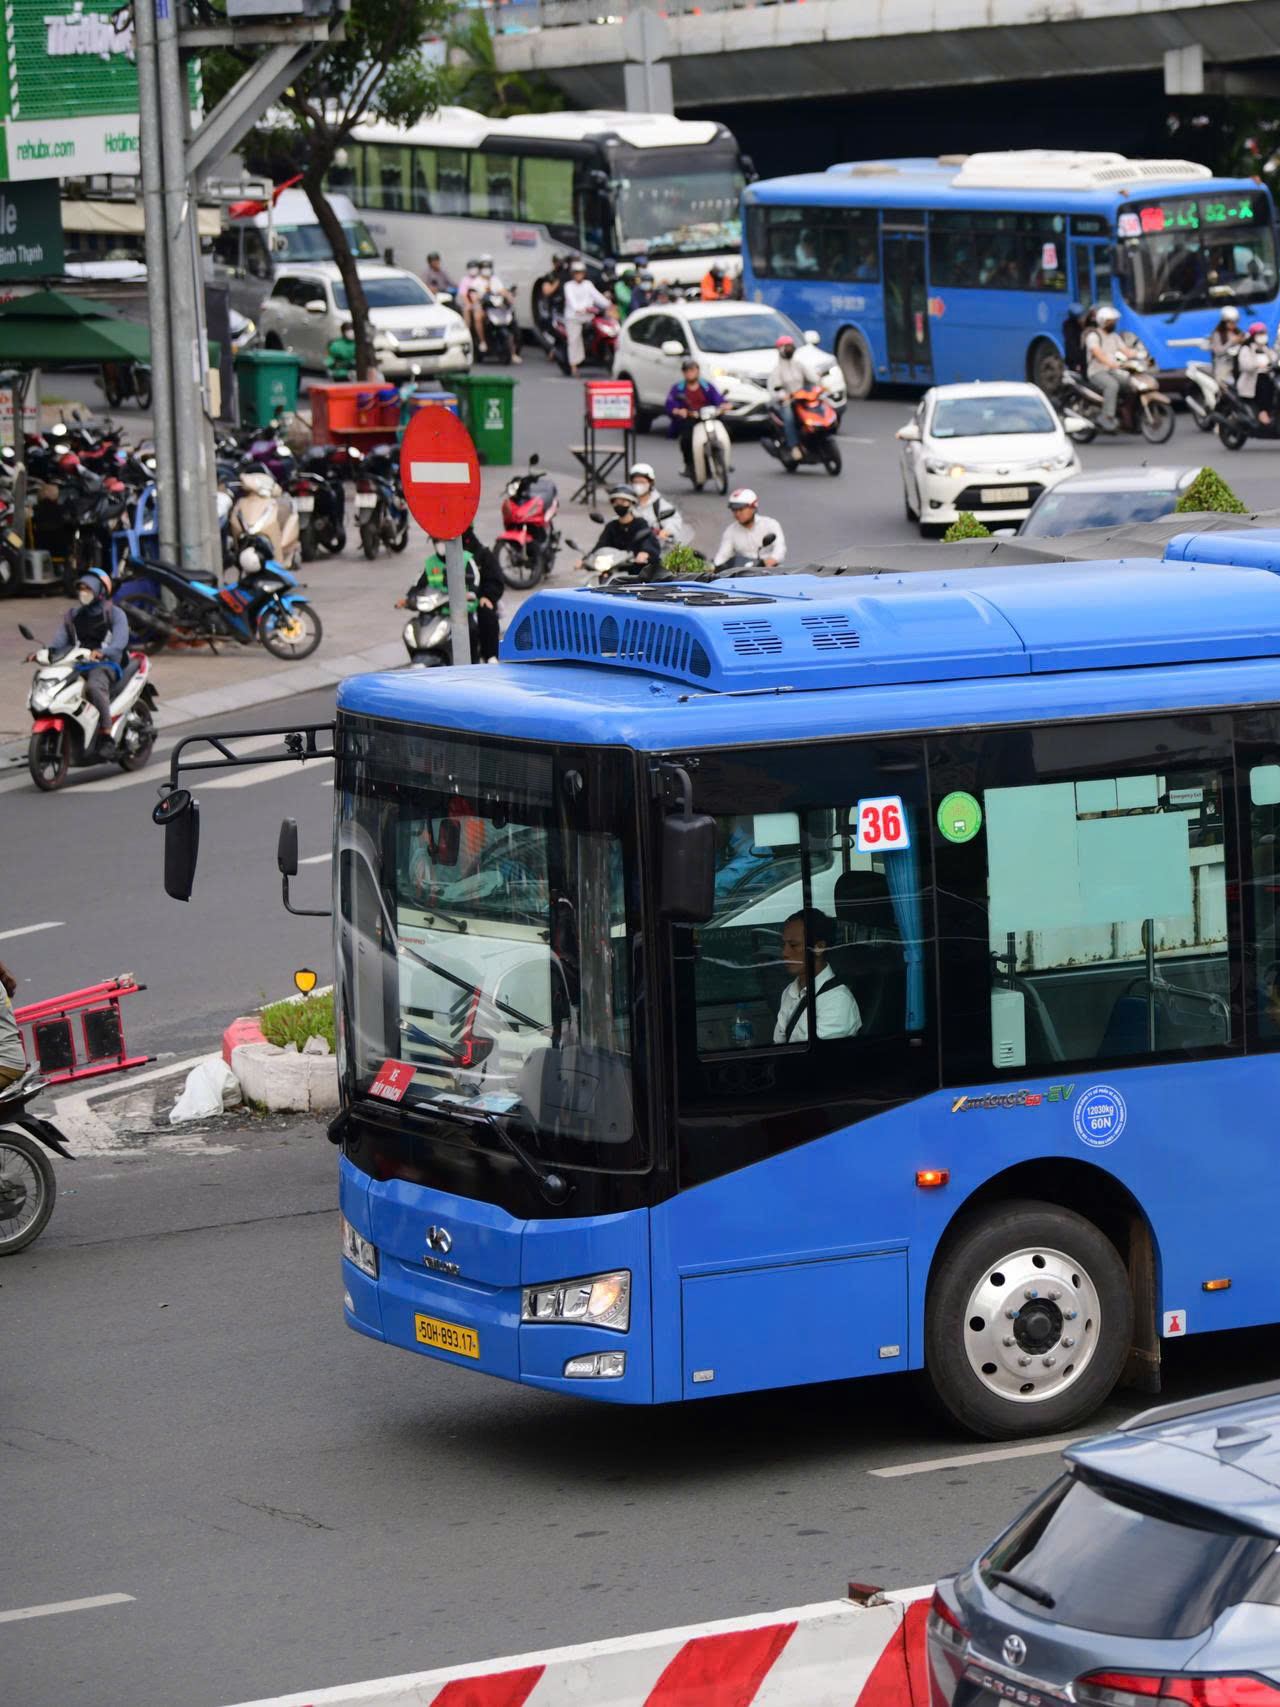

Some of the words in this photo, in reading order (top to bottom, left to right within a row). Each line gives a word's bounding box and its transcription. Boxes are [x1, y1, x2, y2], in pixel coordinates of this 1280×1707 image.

[16, 137, 75, 161] rehubx.com
[862, 804, 901, 844] 36
[1091, 1117, 1112, 1130] 60N
[420, 1320, 473, 1352] 50H-893.17
[982, 1674, 1042, 1705] CROSS
